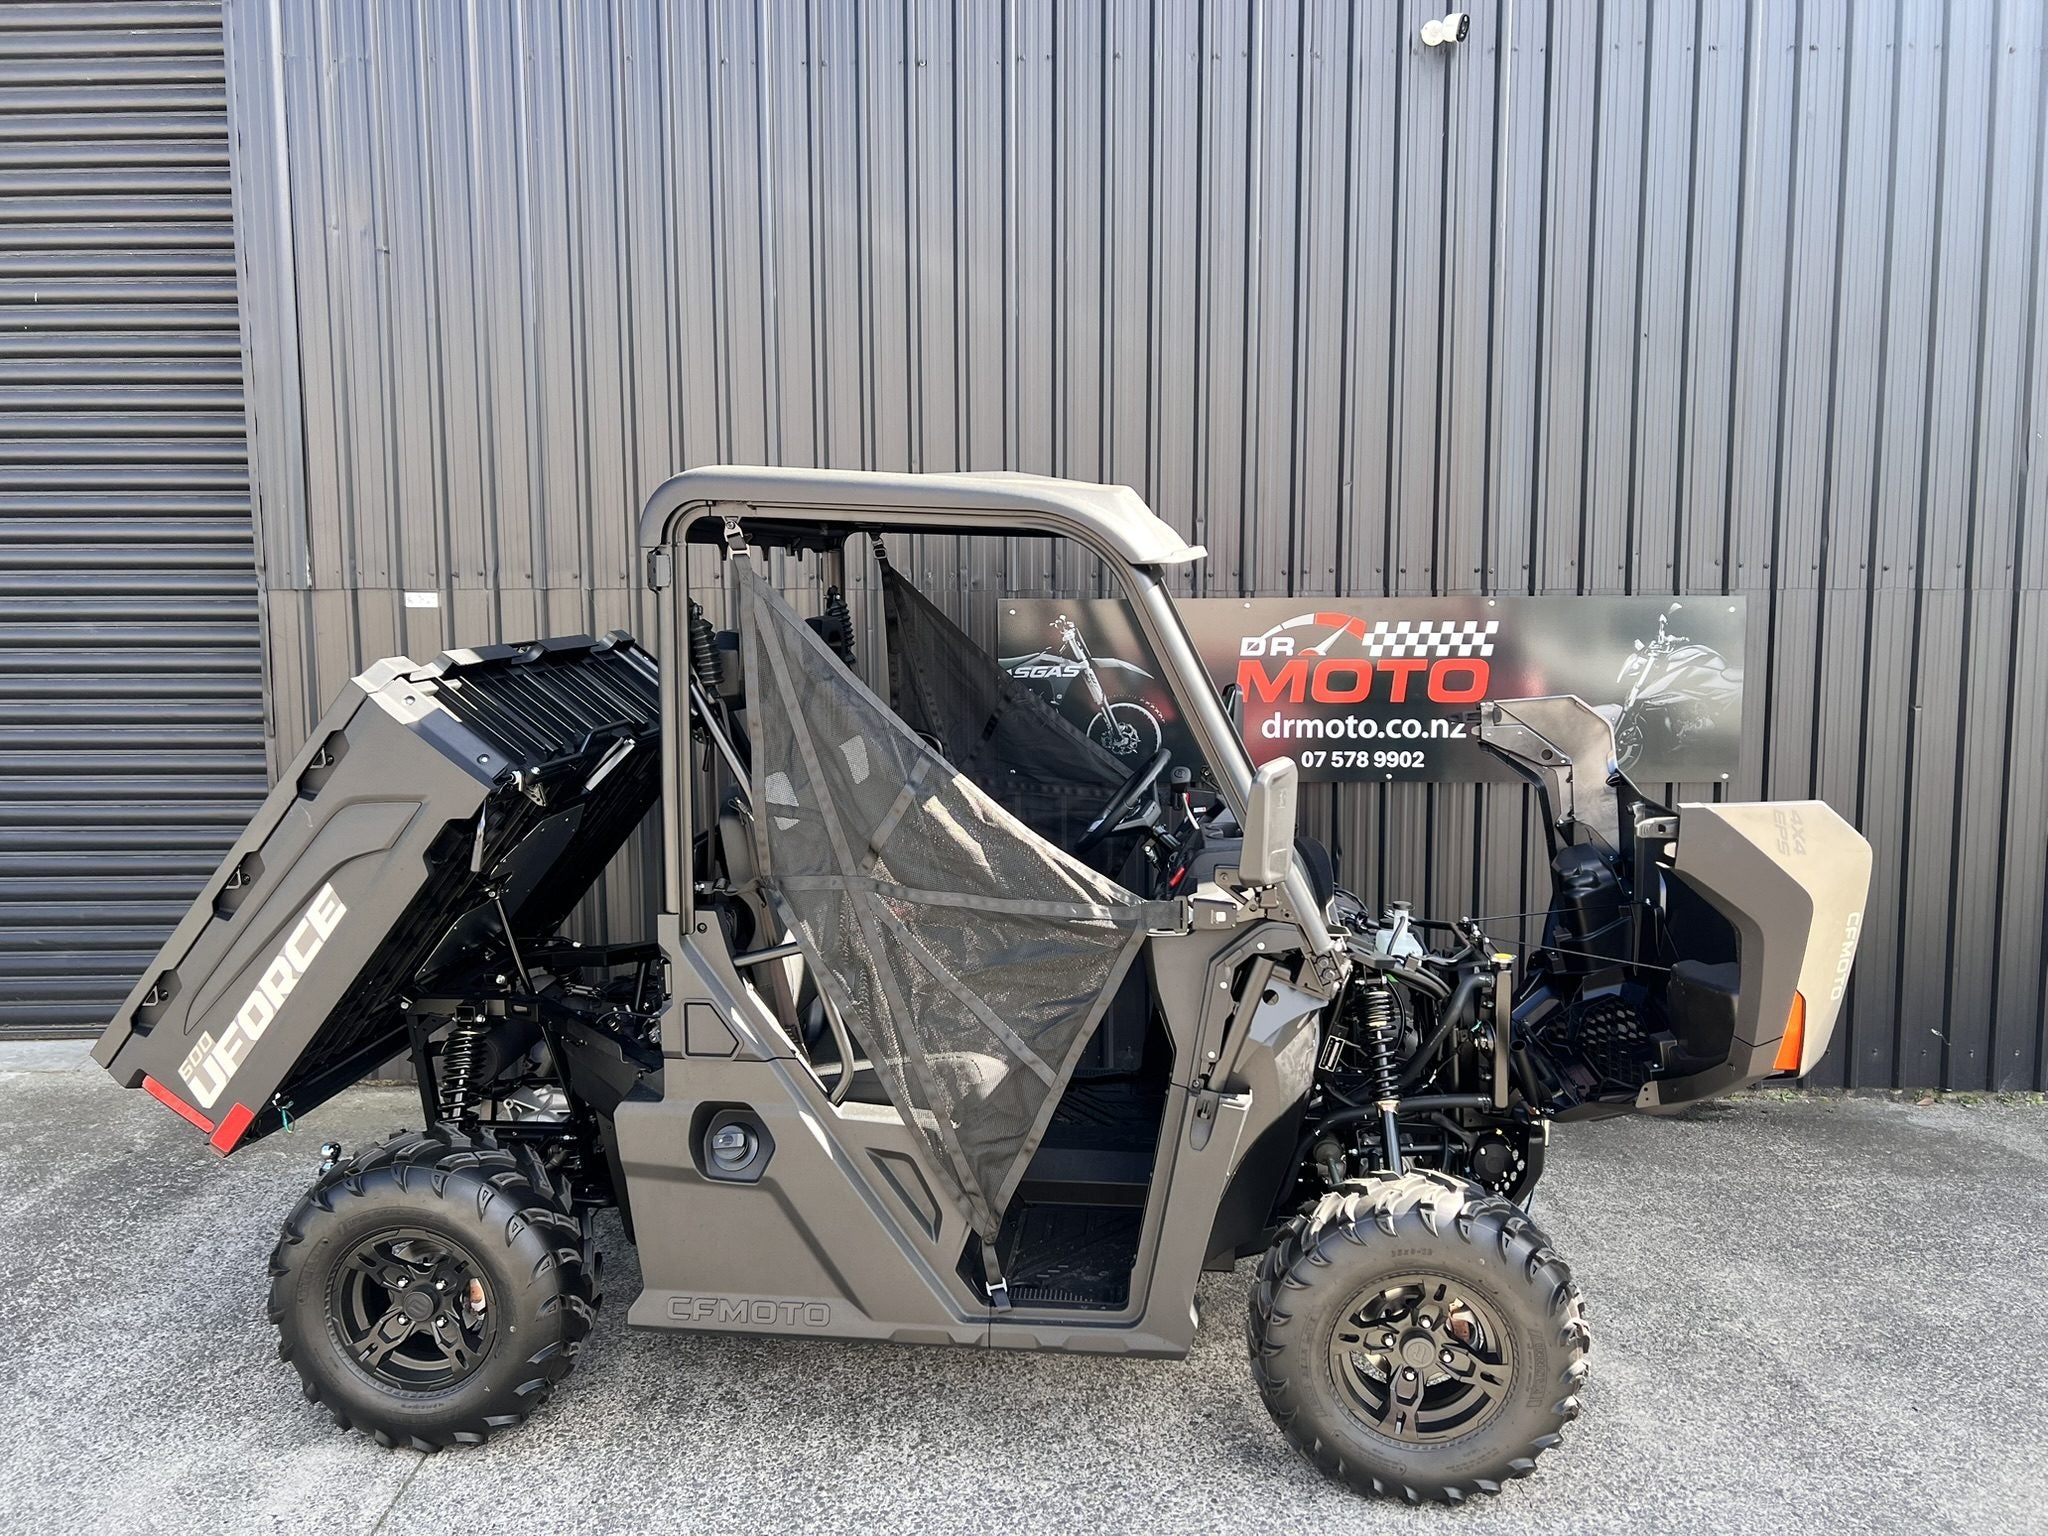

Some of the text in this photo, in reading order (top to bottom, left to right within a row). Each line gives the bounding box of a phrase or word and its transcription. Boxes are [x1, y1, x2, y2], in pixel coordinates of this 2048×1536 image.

[1240, 636, 1295, 656] DR
[1236, 658, 1490, 703] MOTO
[1261, 712, 1467, 739] drmoto.co.nz
[1301, 751, 1425, 768] 07 578 9902
[1773, 809, 1790, 856] EPS
[1830, 911, 1860, 1001] CFMOTO
[186, 881, 348, 1108] UFORCE
[178, 1030, 217, 1084] 500
[667, 1296, 831, 1327] CFMOTO
